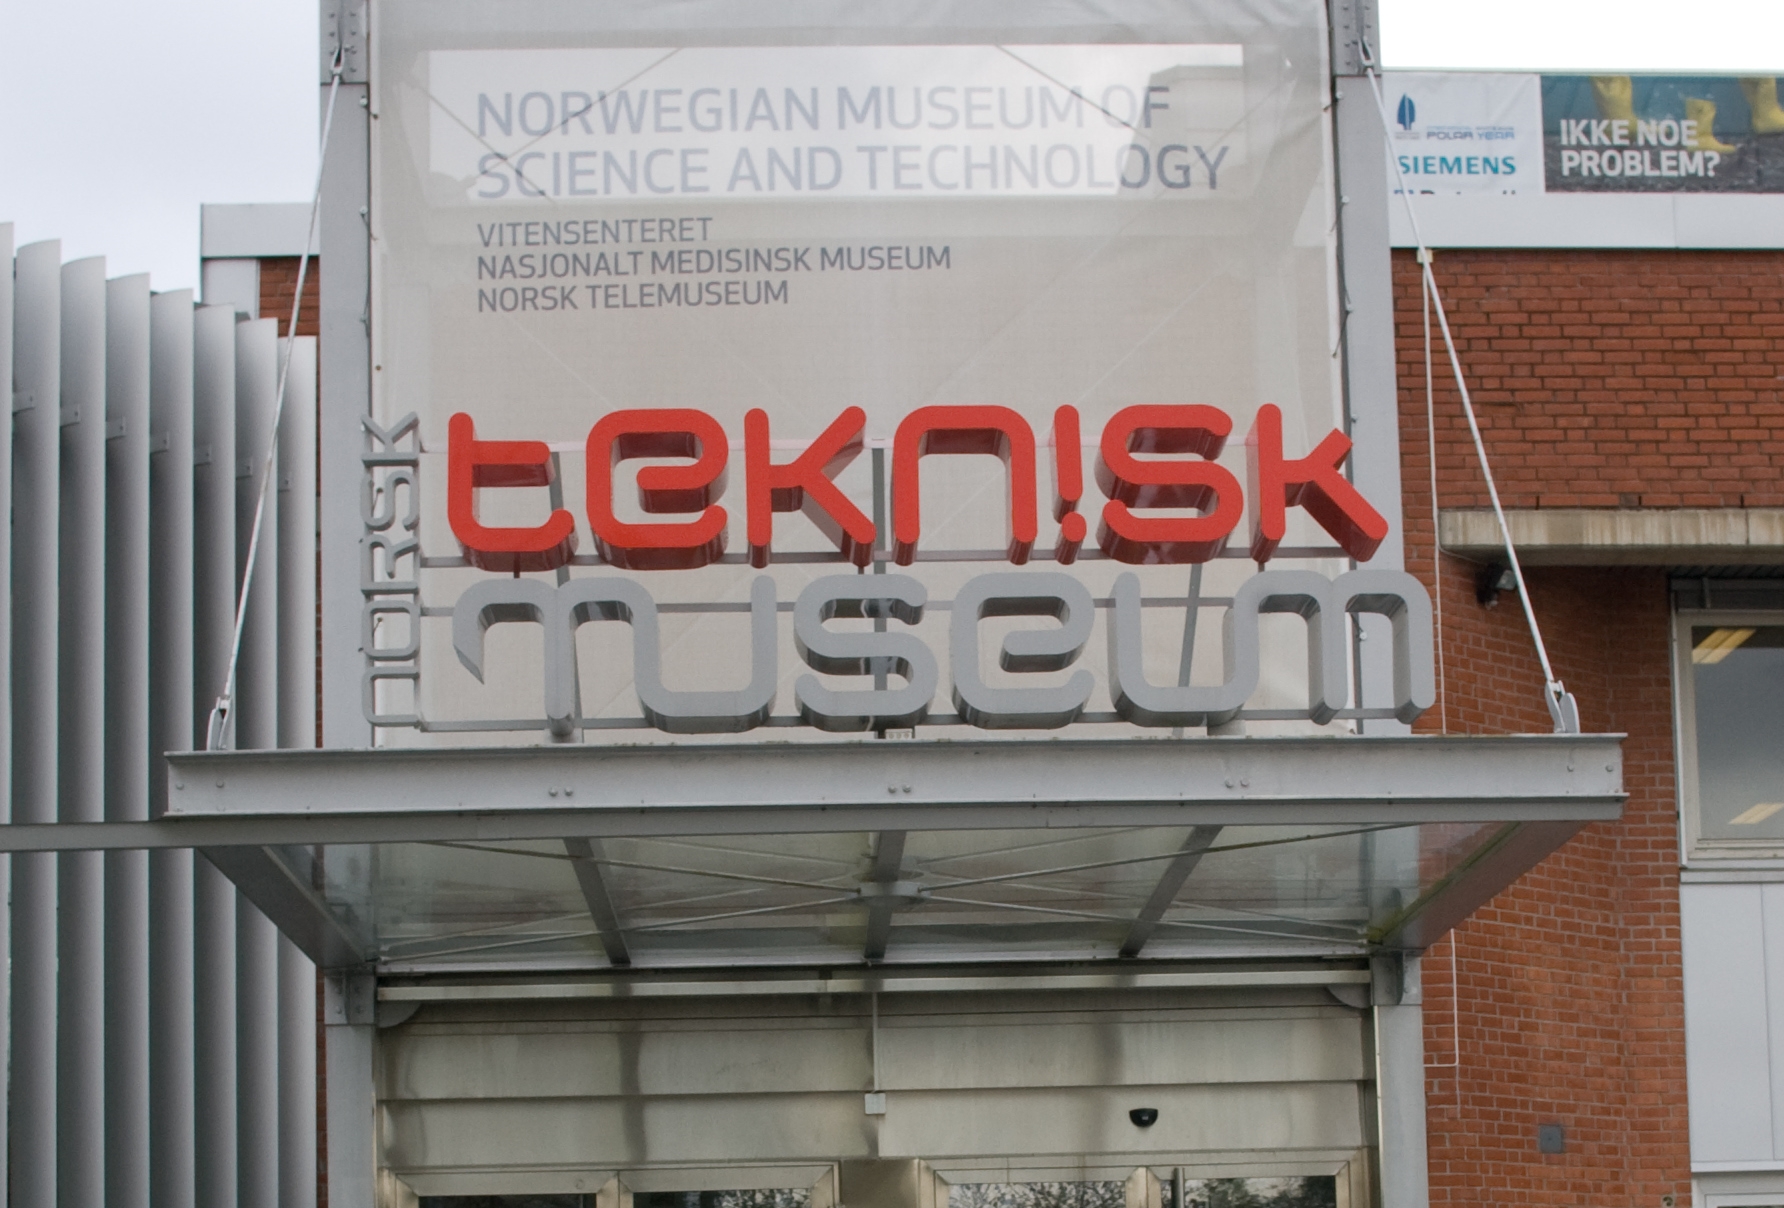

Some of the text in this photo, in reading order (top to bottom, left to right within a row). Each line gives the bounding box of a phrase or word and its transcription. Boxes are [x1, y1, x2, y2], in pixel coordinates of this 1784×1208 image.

[477, 84, 1170, 137] NORWEGIAN MUSEUM OF
[1560, 118, 1699, 147] IKKE NOE
[477, 144, 1229, 199] SCIENCE AND TECHNOLOGY
[1398, 155, 1517, 175] SIEMENS
[1561, 150, 1721, 178] PROBLEM?
[477, 217, 713, 248] VITENSENTERET
[477, 245, 951, 281] NASJONALT MEDISINSK MUSEUM
[477, 280, 789, 313] NORSK TELEMUSEUM
